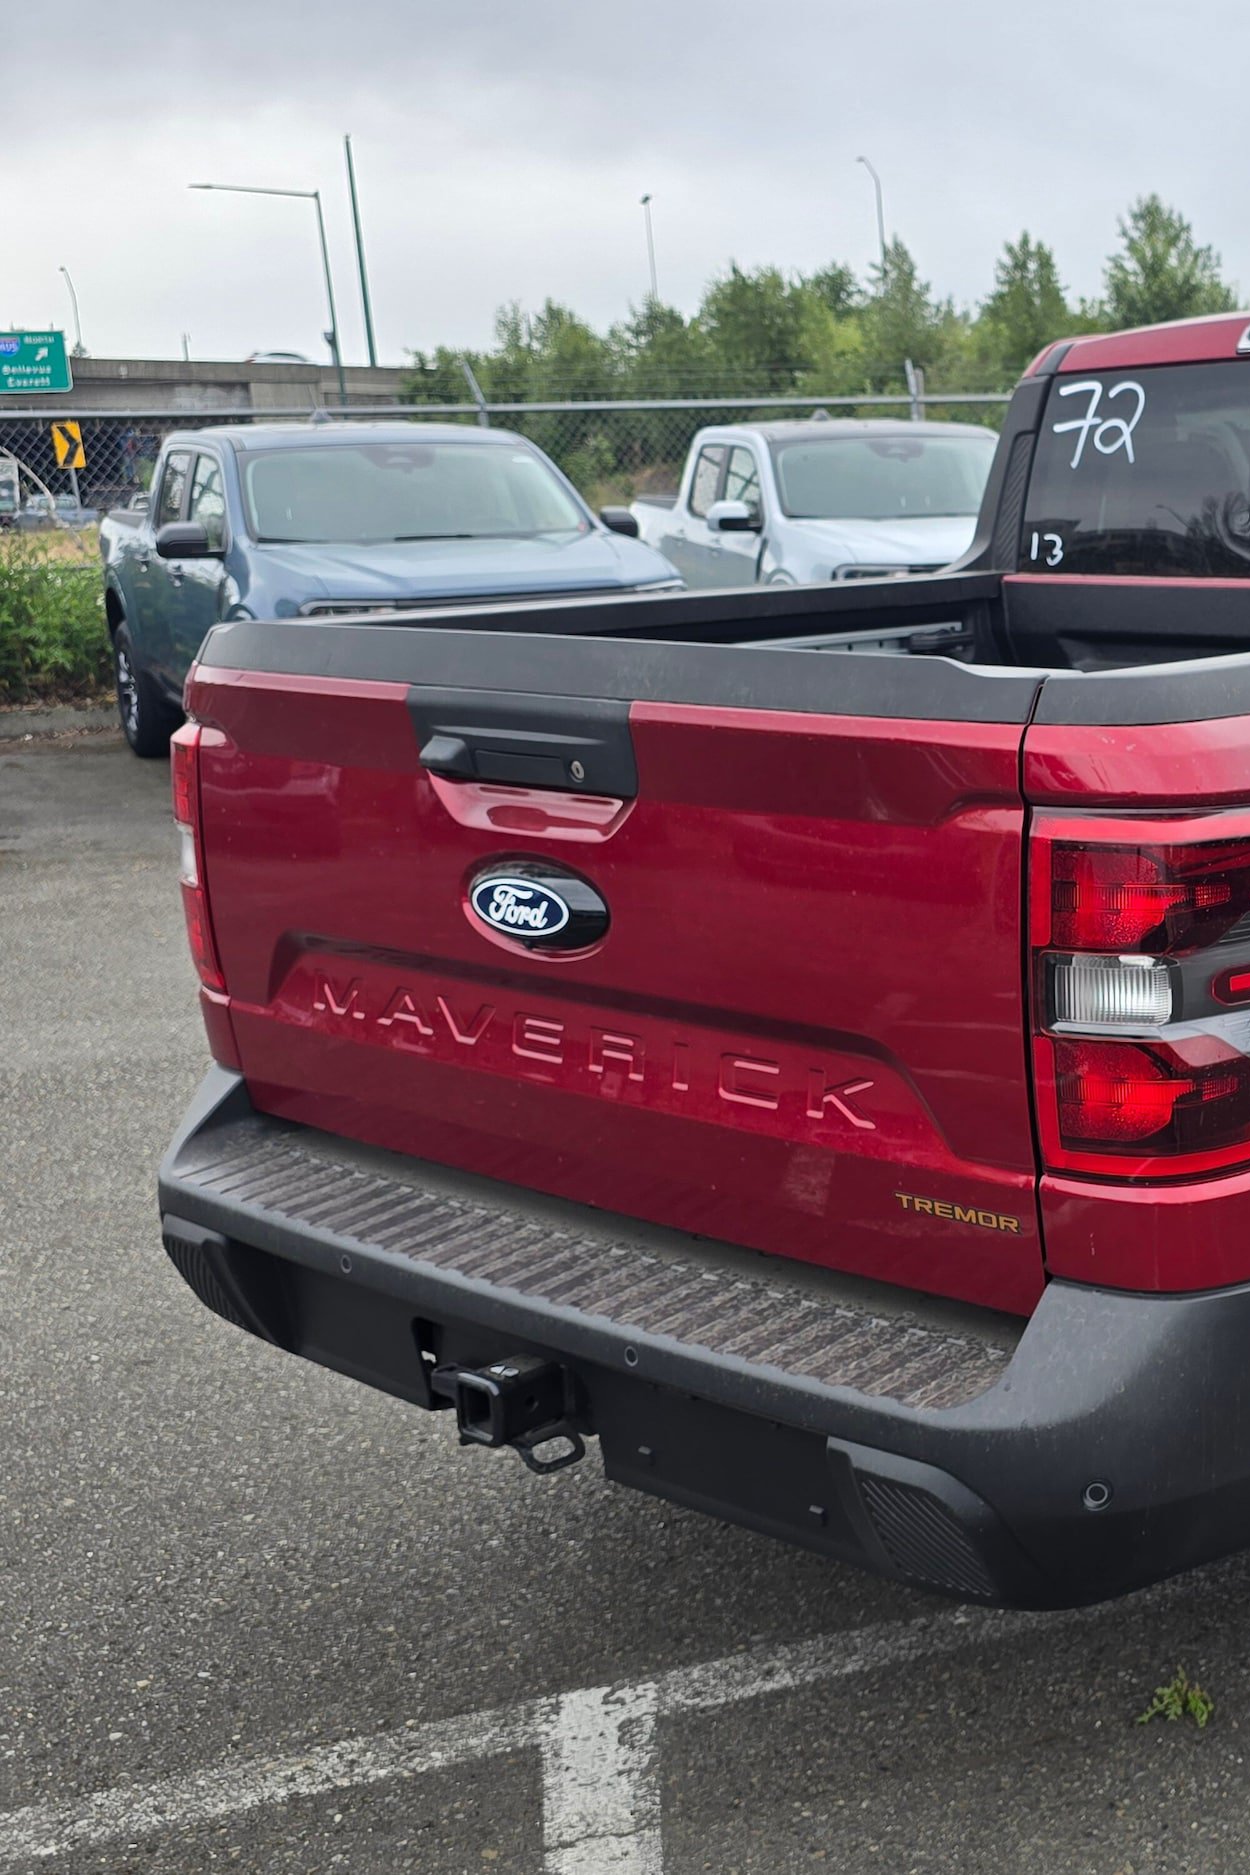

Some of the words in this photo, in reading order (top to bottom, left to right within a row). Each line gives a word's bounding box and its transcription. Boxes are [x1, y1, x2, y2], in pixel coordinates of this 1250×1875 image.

[2, 364, 52, 376] Bellevue
[7, 377, 51, 388] Everett
[1053, 380, 1146, 469] 72
[1030, 532, 1064, 566] 13
[489, 885, 549, 929] Ford
[312, 968, 876, 1130] MAVERICK
[894, 1192, 1020, 1234] TREMOR
